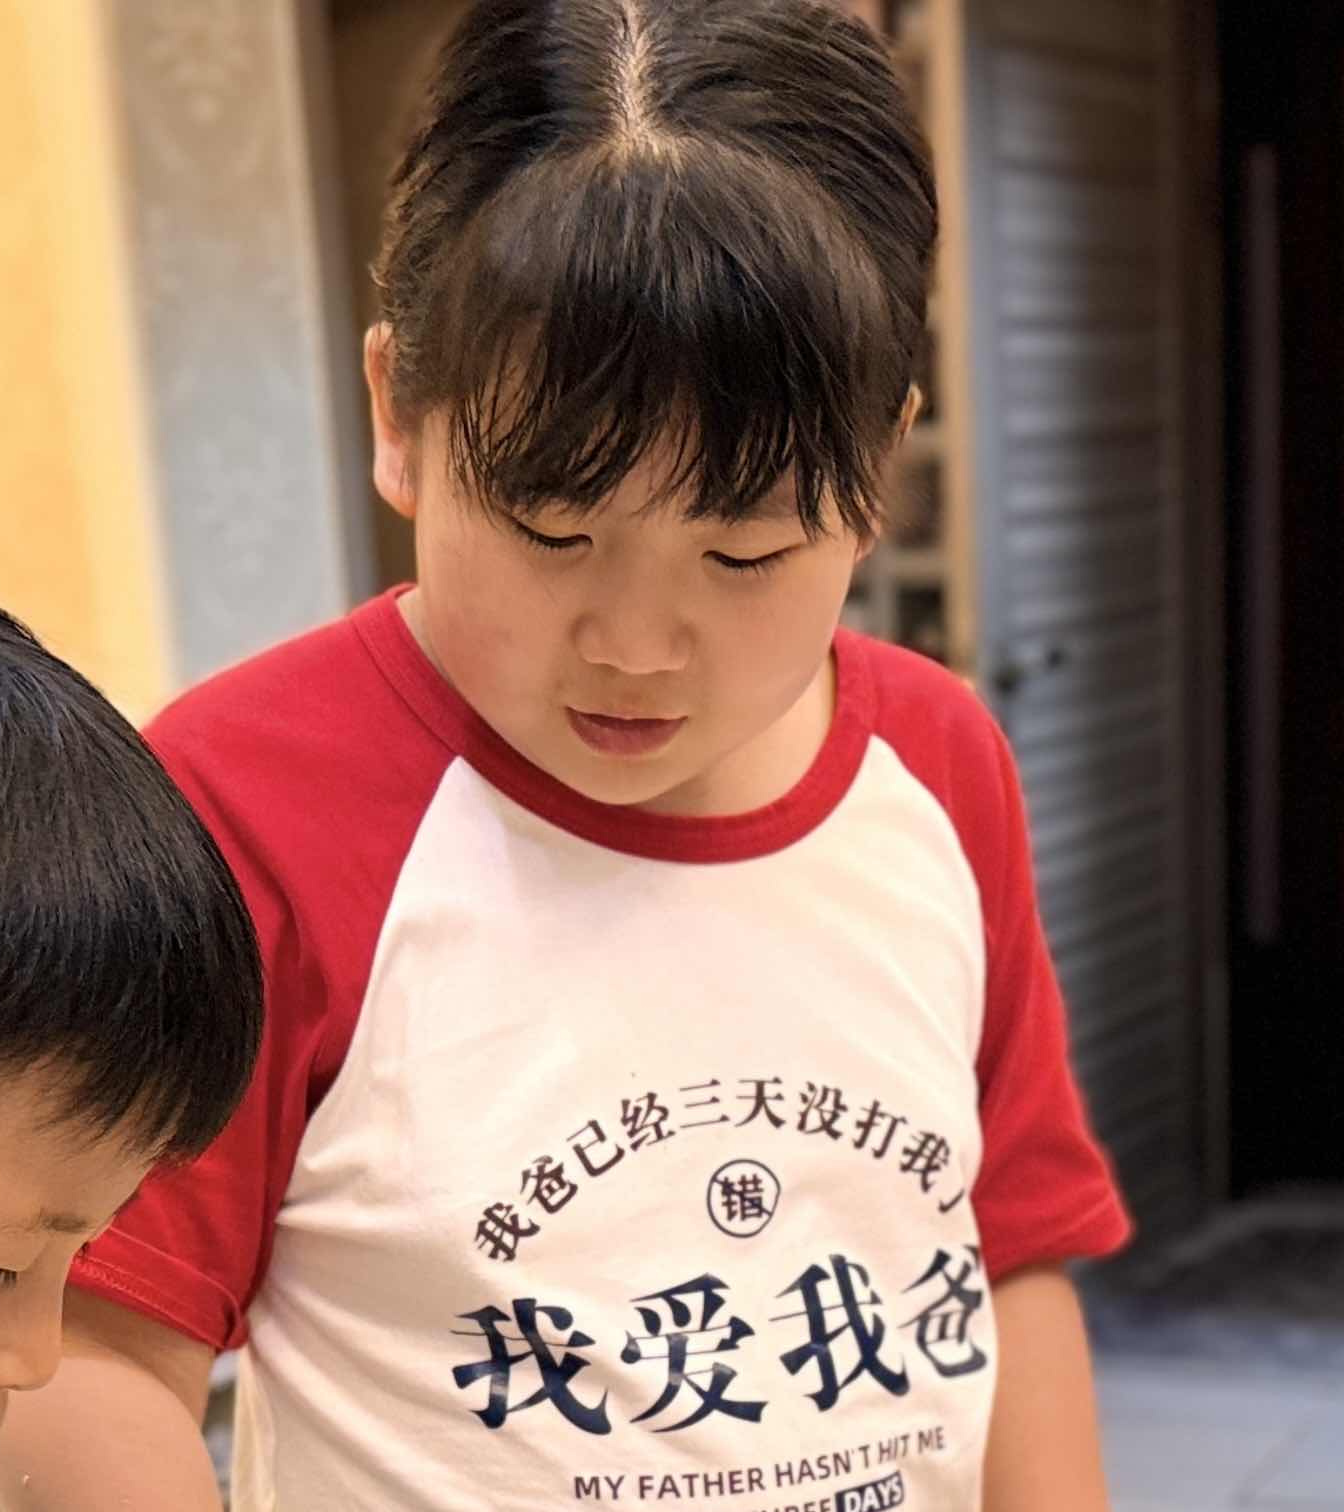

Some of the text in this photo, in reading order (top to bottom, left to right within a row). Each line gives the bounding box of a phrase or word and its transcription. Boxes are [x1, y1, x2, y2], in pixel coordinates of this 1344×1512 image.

[451, 1245, 987, 1435] 我爱我爸
[574, 1475, 624, 1500] MY
[639, 1467, 765, 1500] FATHER
[878, 1434, 911, 1464] HIT
[917, 1426, 946, 1454] ME
